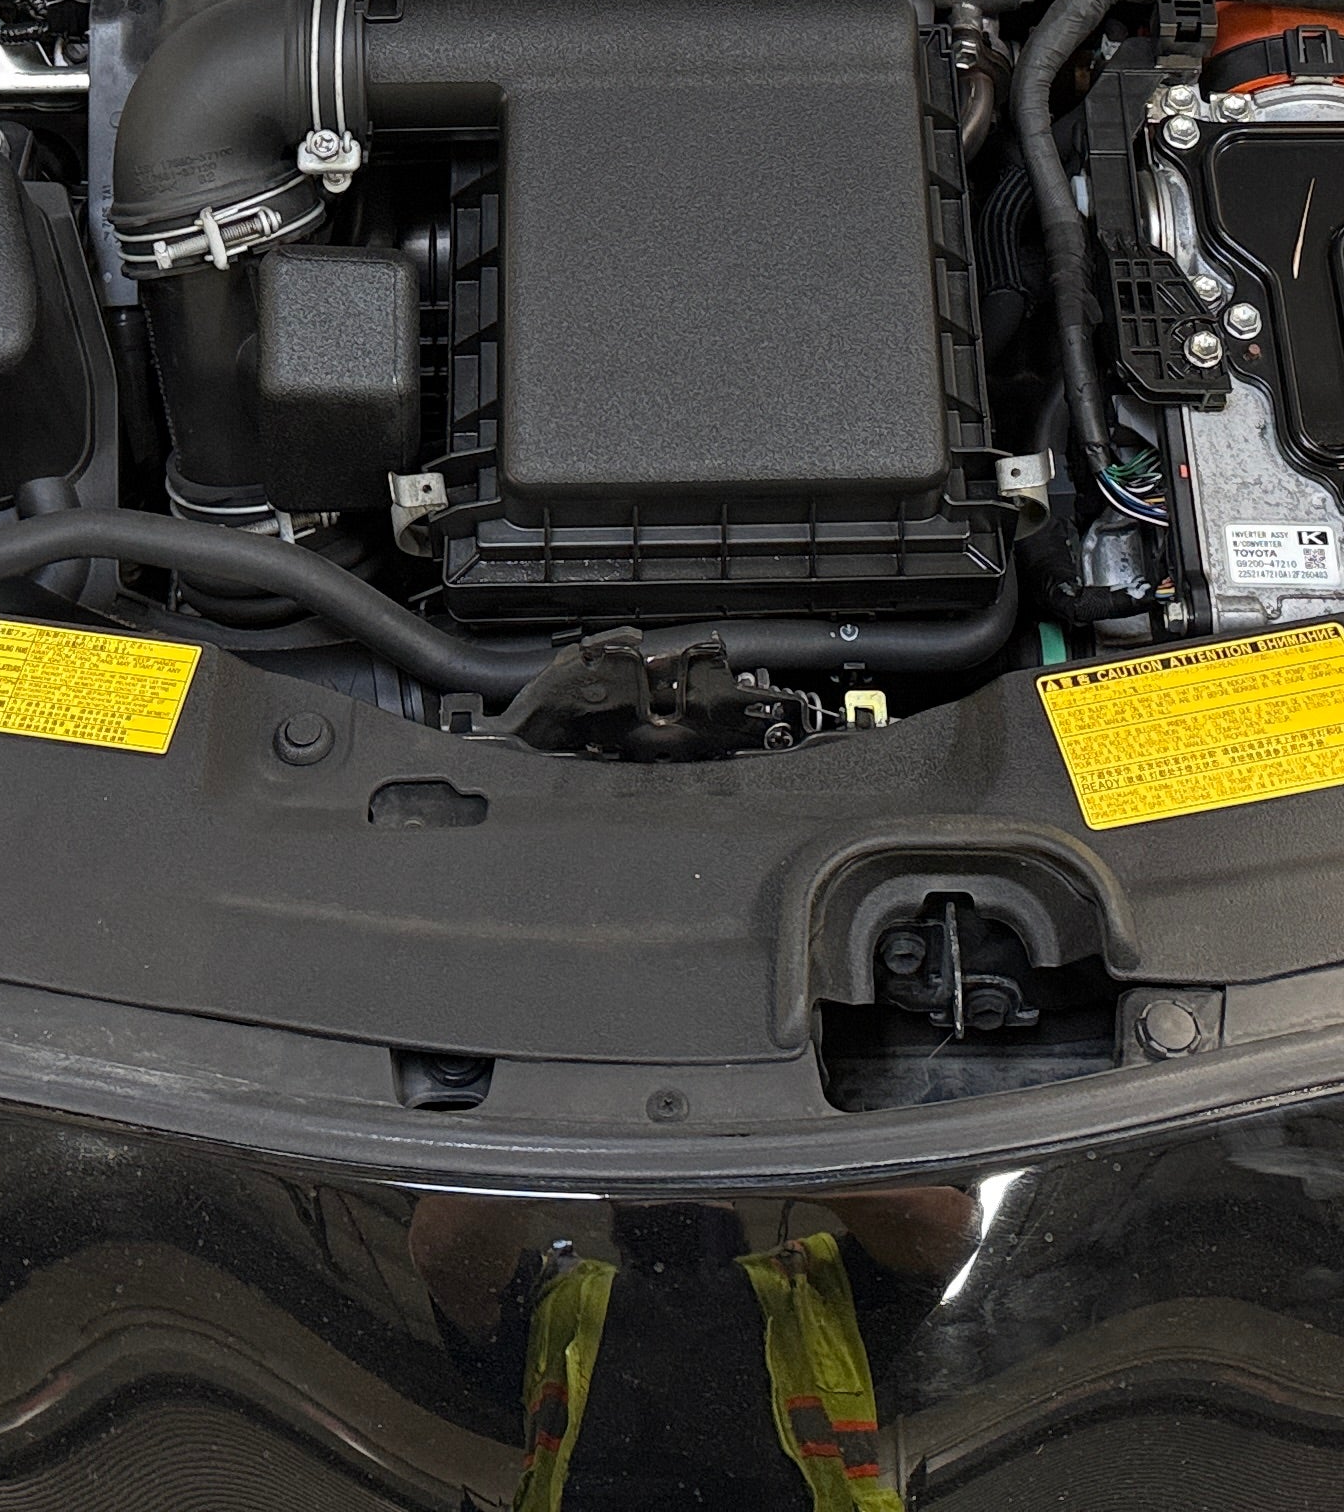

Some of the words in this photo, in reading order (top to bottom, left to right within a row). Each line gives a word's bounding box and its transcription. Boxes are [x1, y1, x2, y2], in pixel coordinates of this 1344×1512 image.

[1231, 530, 1267, 538] INVERTER
[1269, 530, 1289, 538] ASSY
[1233, 548, 1277, 557] TOYOTA
[1235, 559, 1297, 568] G9200-47210
[1094, 659, 1164, 682] CAUTION
[1166, 642, 1254, 668] ATTENTION
[1255, 626, 1339, 652] ВНИМАНИЕ
